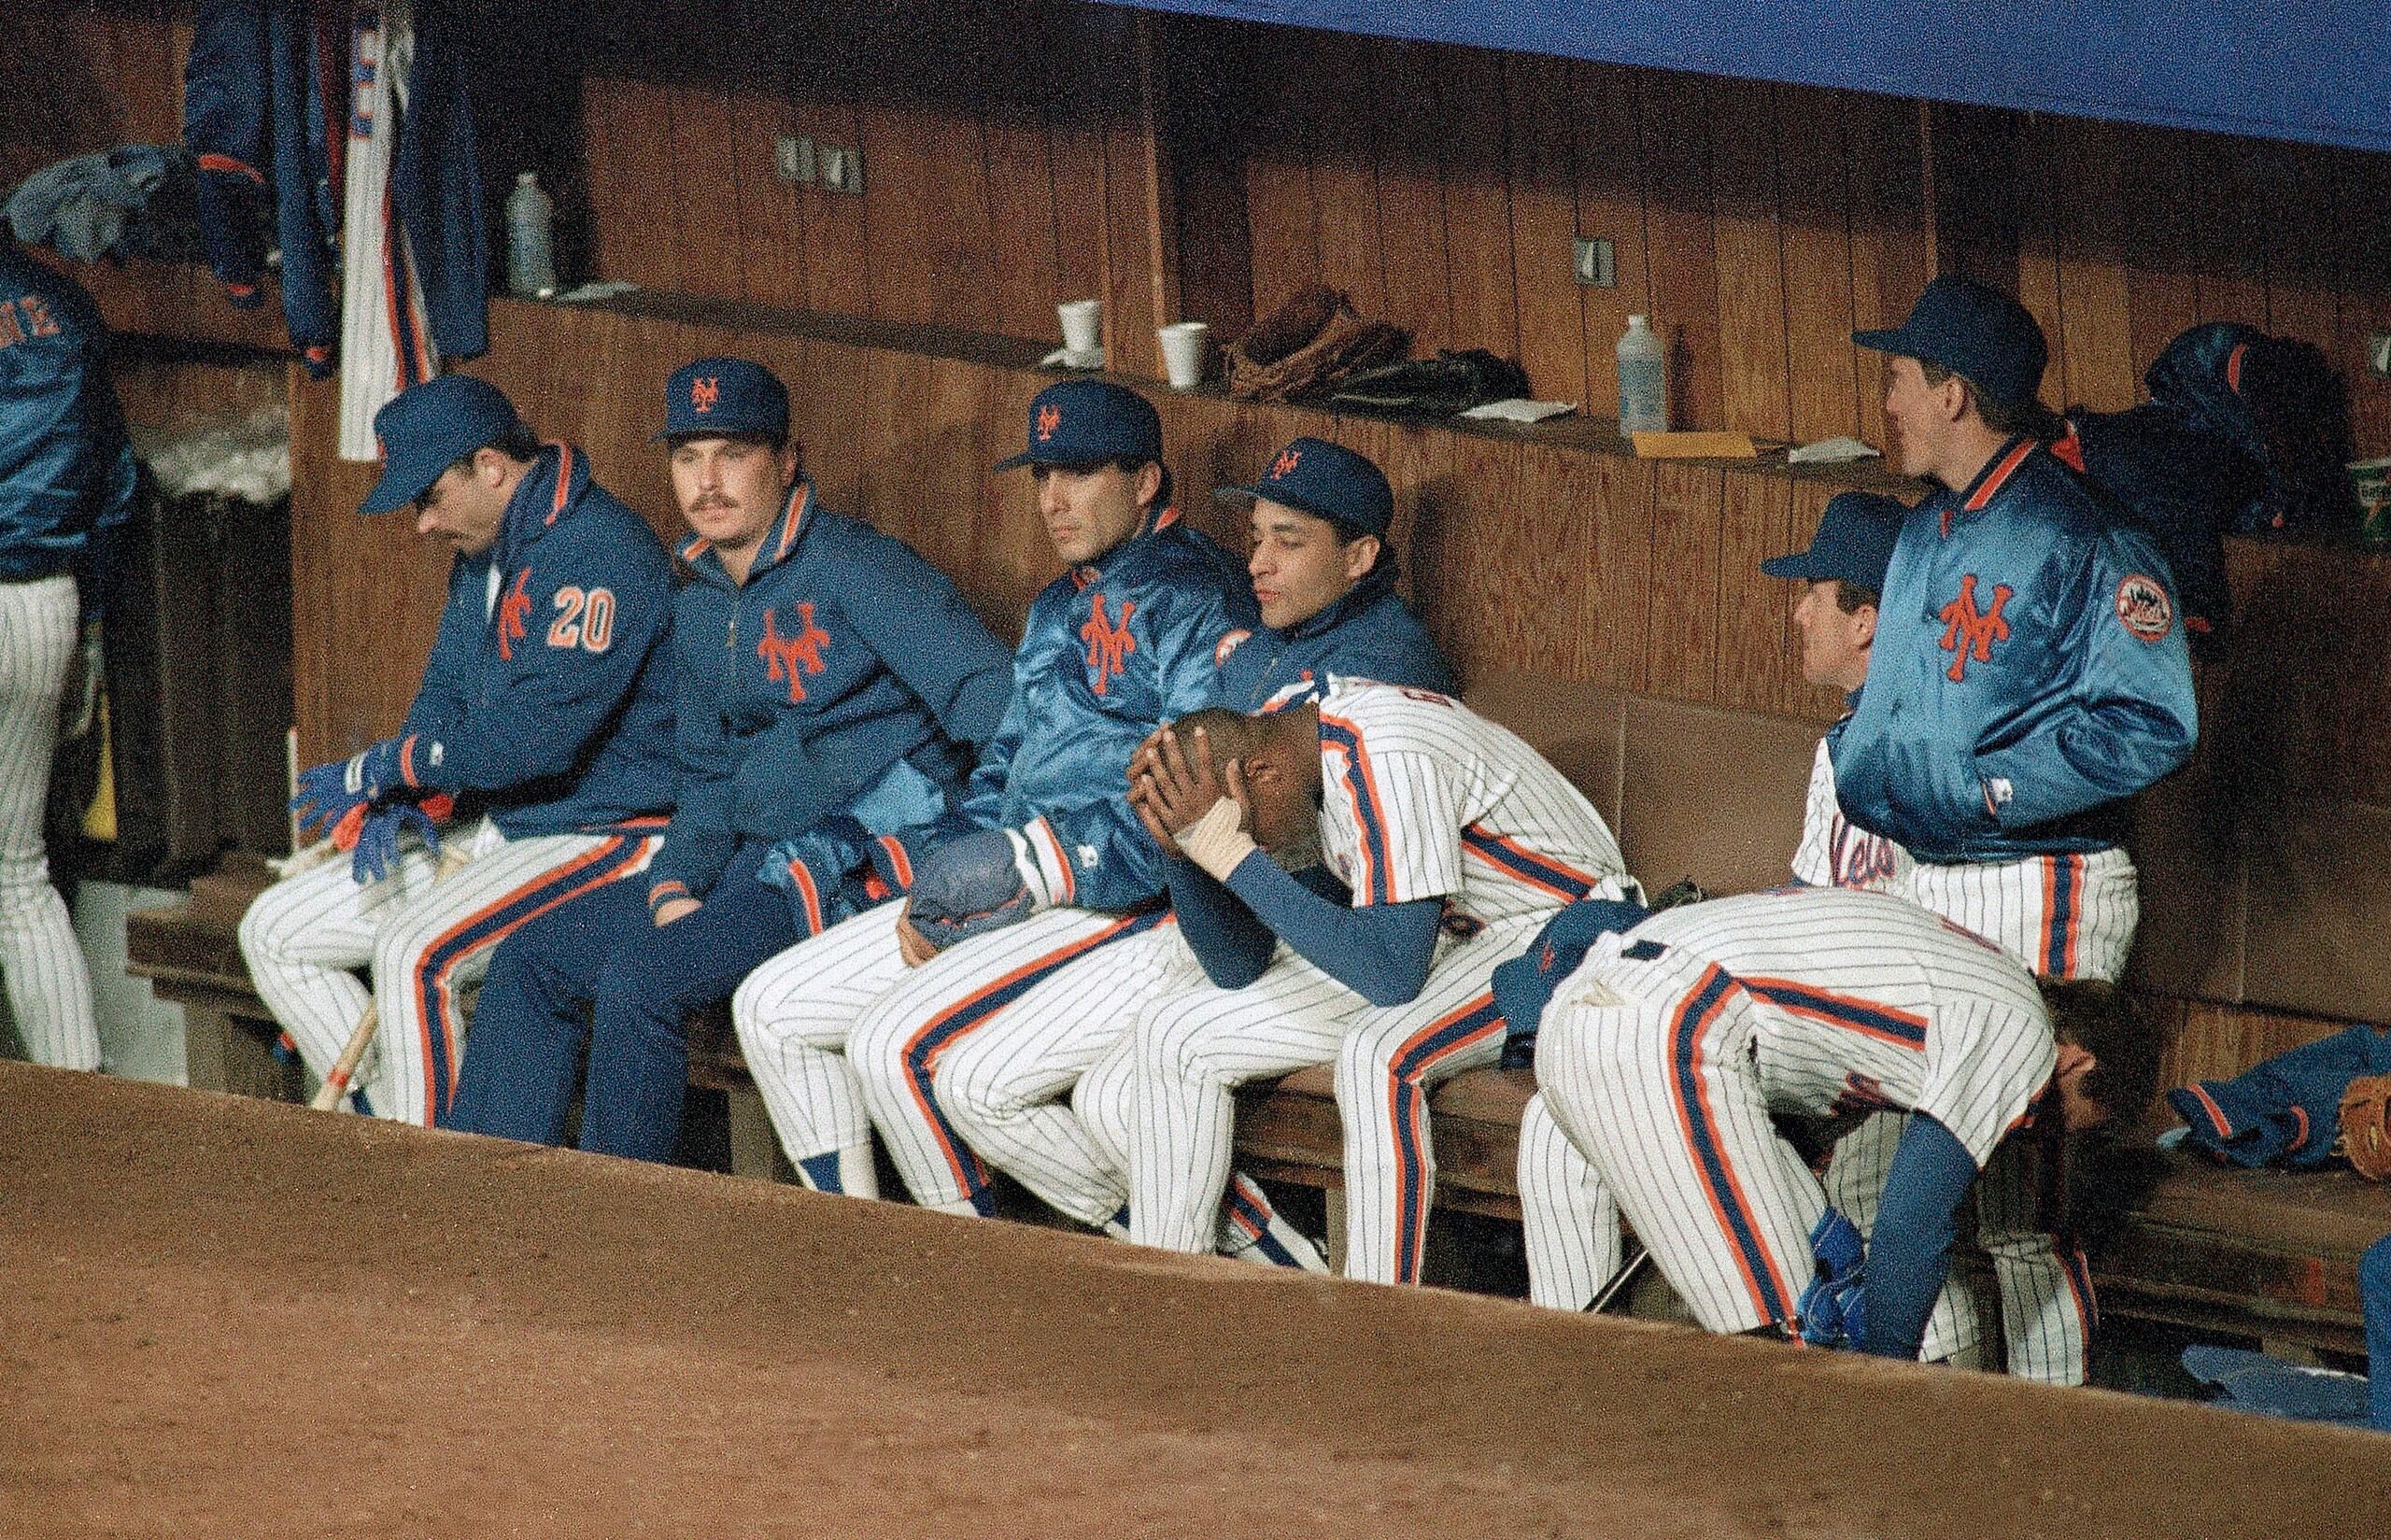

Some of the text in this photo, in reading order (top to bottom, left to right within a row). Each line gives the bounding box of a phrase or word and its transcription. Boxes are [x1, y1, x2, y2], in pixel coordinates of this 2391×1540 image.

[692, 376, 718, 412] NY
[1038, 404, 1060, 441] NY
[547, 586, 615, 652] 20
[757, 601, 830, 702] NY
[1081, 593, 1136, 695] NY
[1938, 572, 2014, 683] NY
